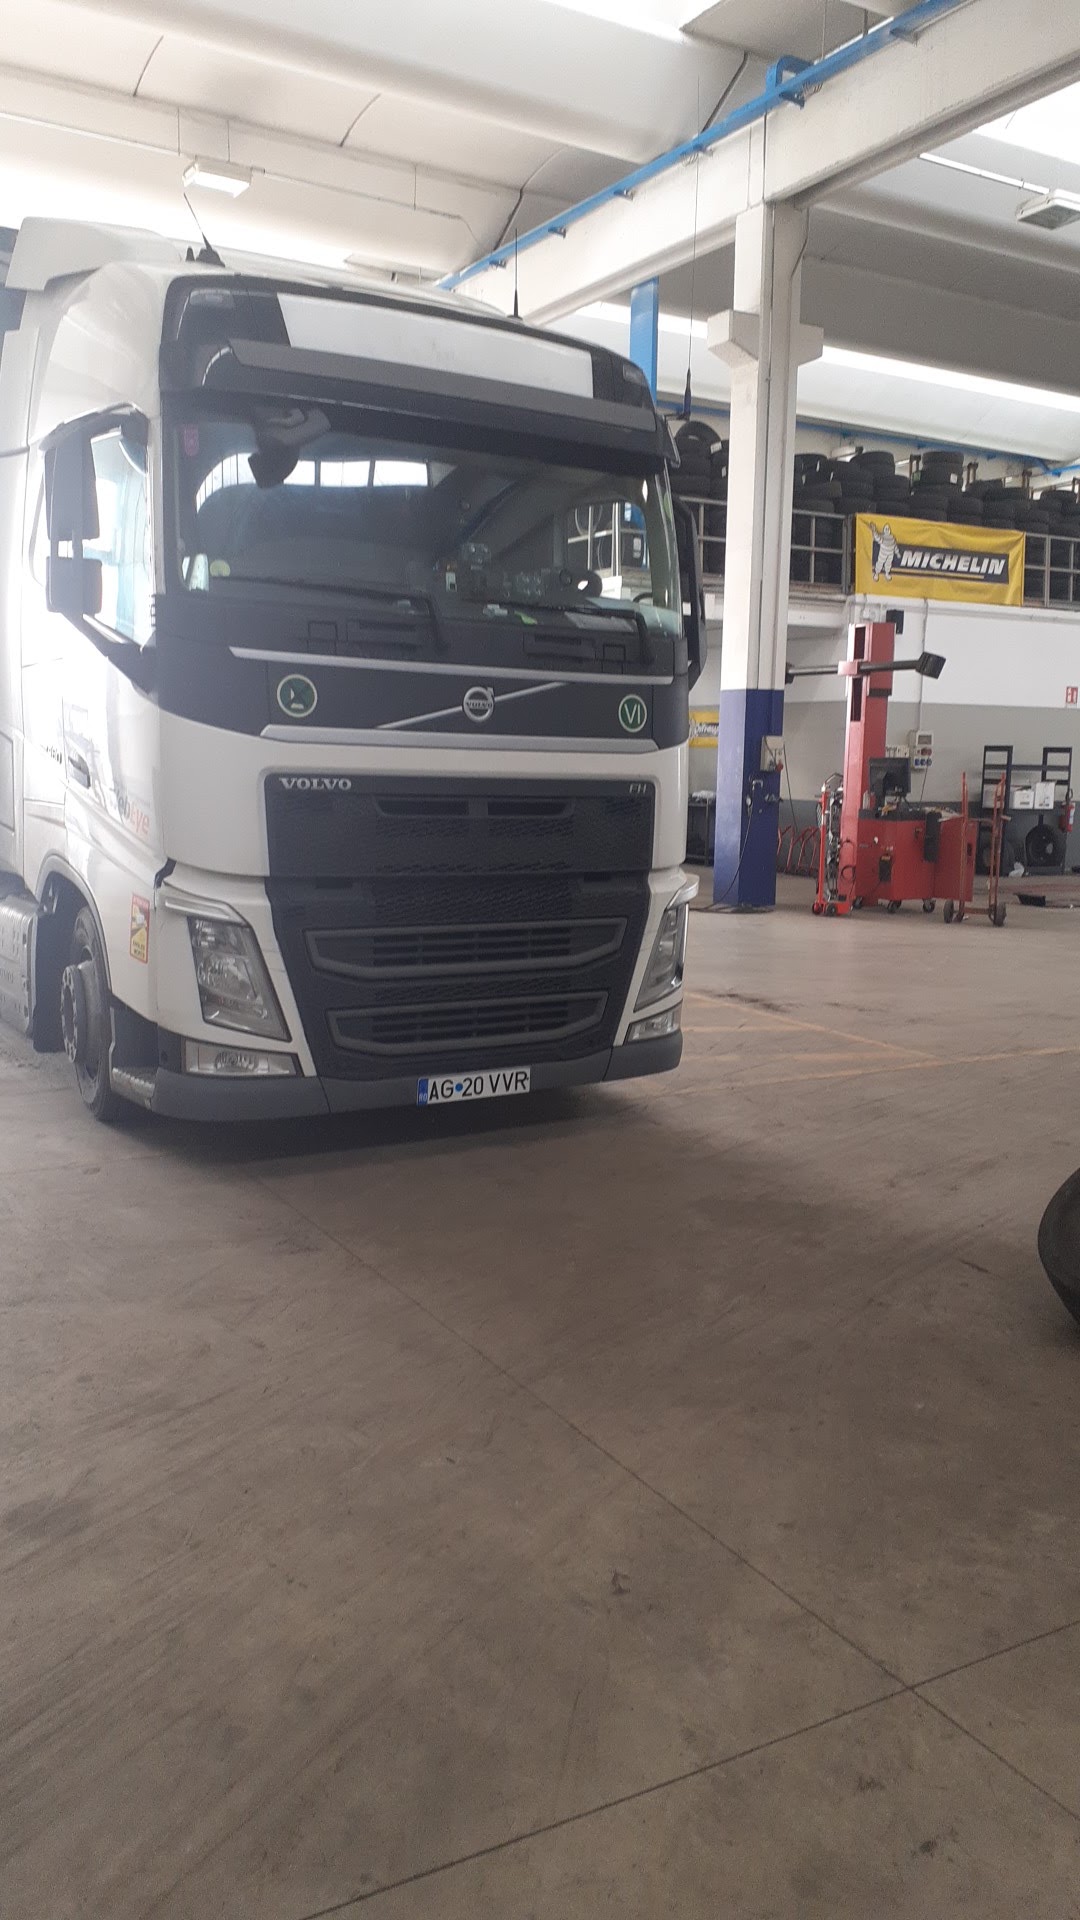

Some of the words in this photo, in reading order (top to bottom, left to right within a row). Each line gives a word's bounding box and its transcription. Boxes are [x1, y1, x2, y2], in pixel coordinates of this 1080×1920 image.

[901, 551, 1005, 575] MICHELIN
[624, 703, 641, 725] VI
[278, 777, 352, 790] VOLVO
[629, 783, 647, 794] FH
[429, 1080, 454, 1101] AG
[462, 1076, 484, 1097] 20
[489, 1071, 527, 1093] VVR
